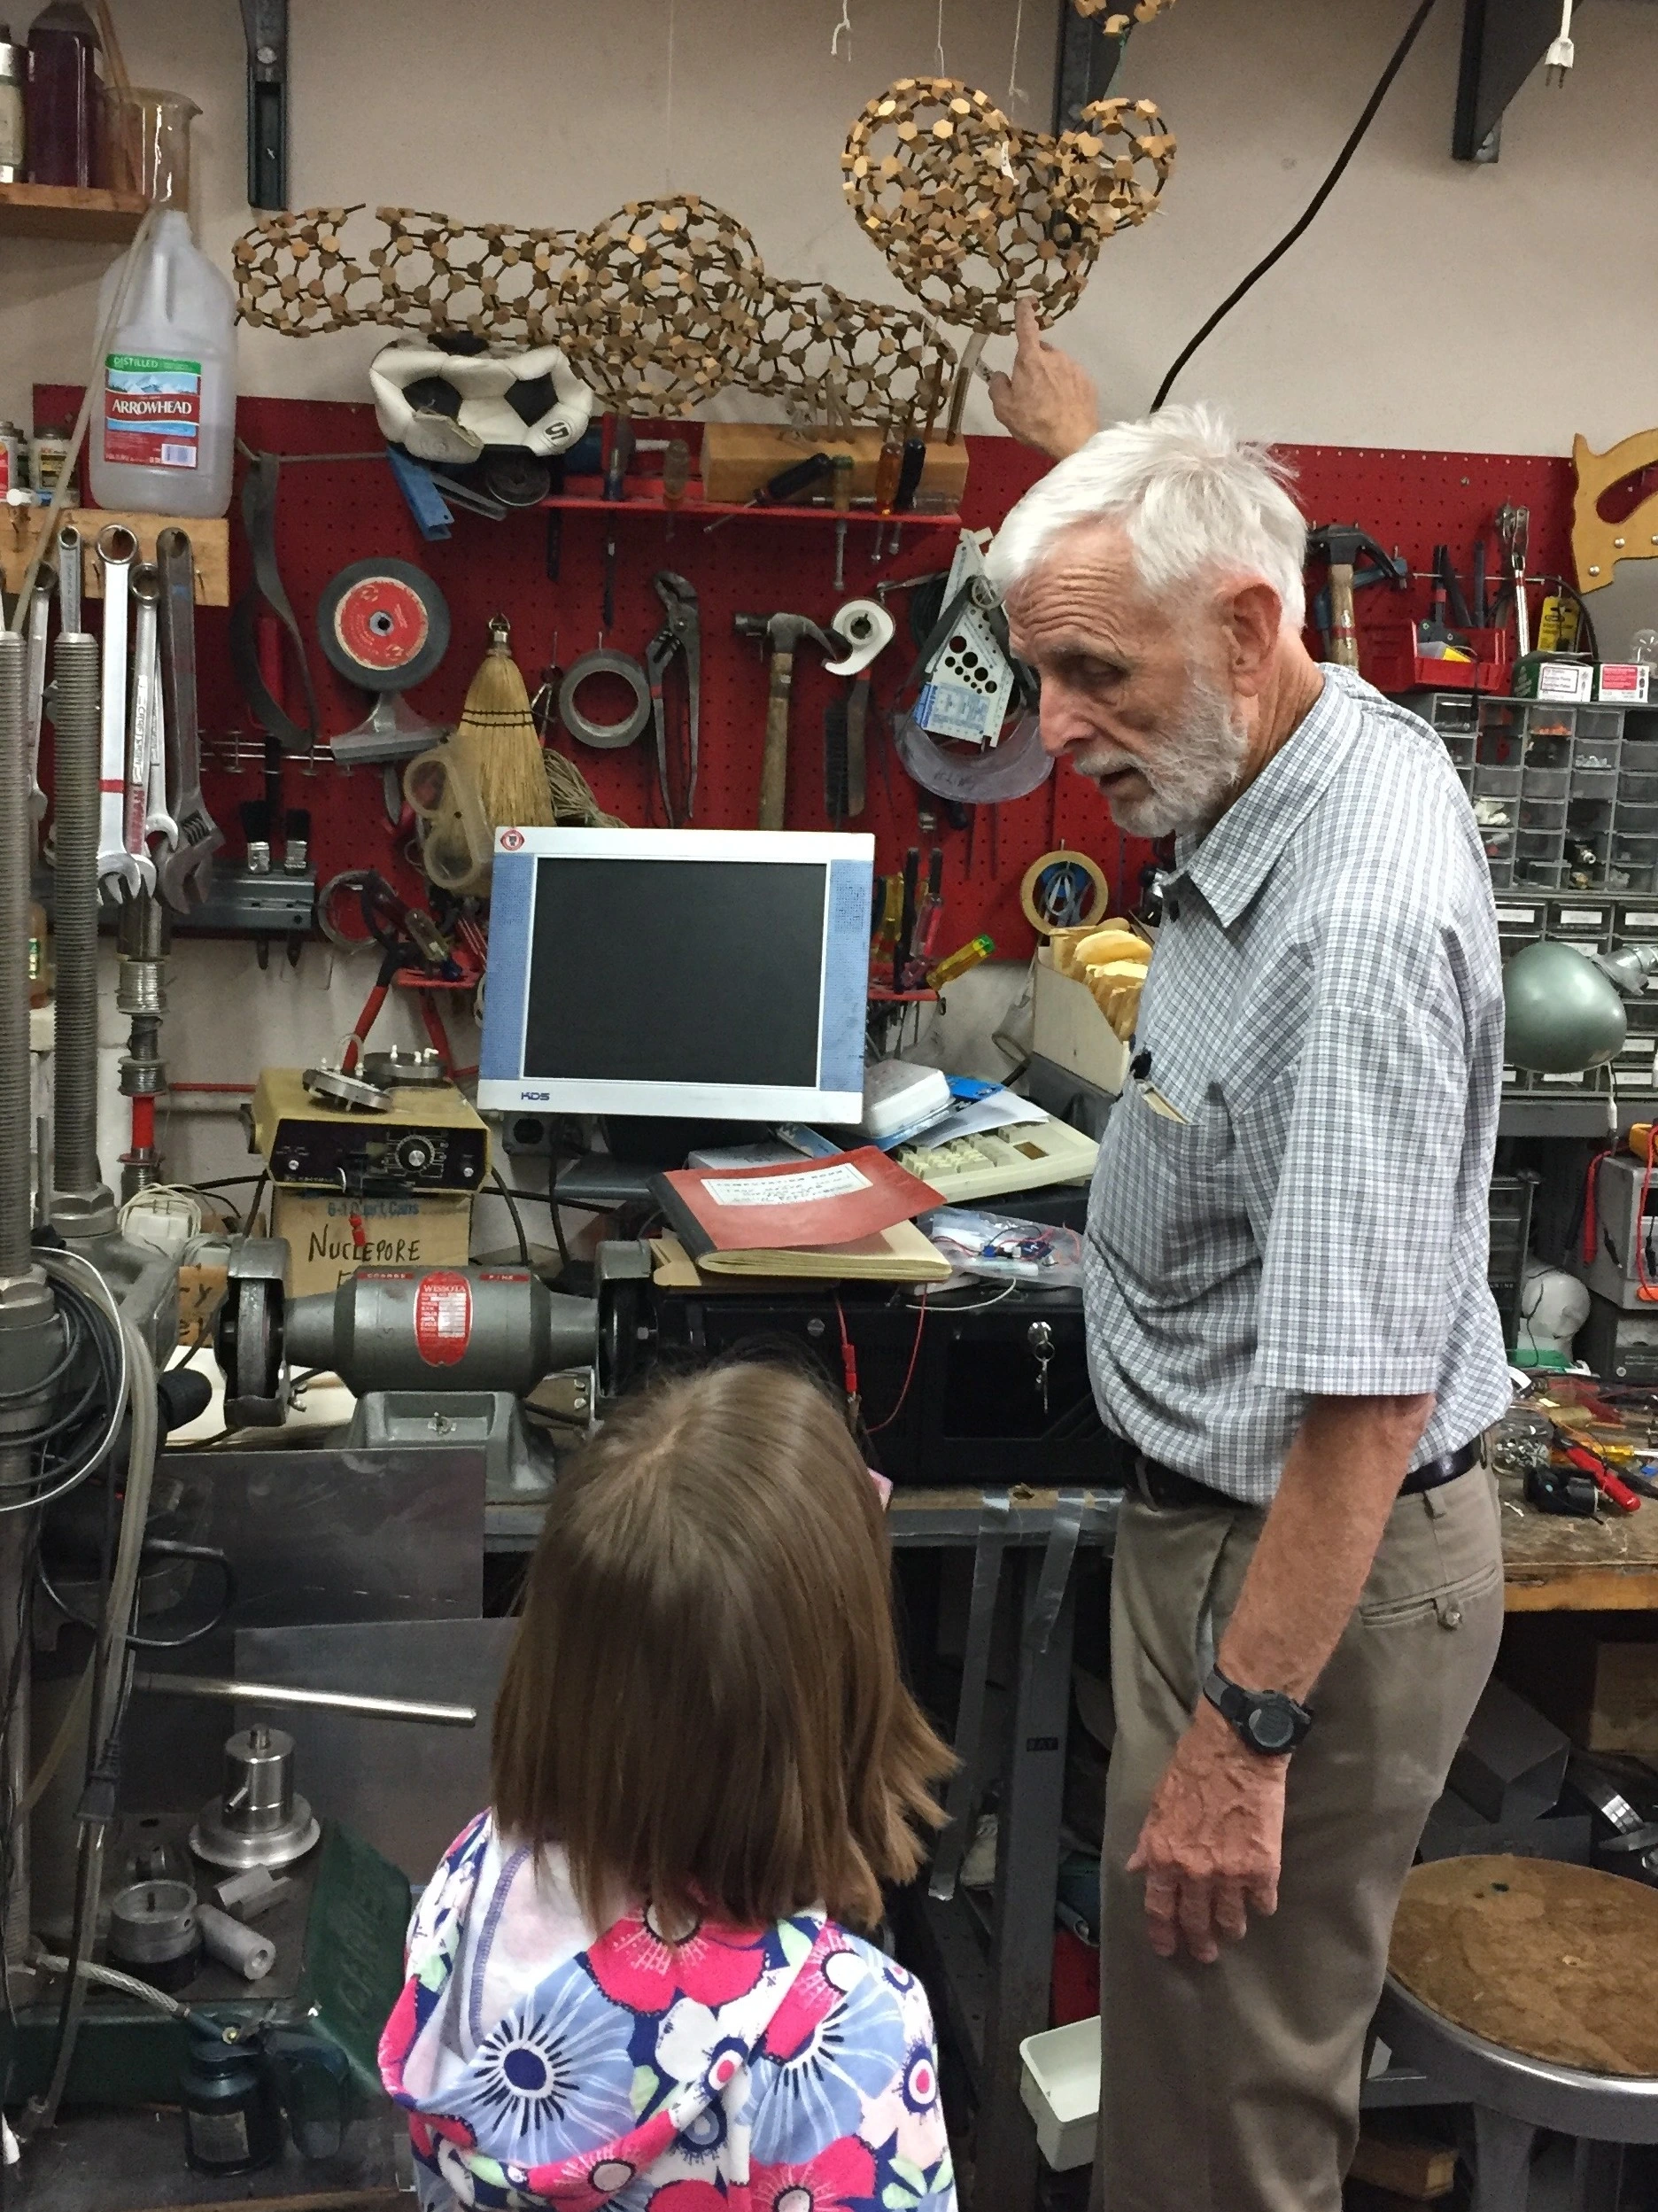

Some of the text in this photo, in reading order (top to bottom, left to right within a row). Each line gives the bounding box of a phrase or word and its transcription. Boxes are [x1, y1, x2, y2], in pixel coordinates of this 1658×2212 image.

[113, 356, 159, 368] DISTILLED
[112, 399, 192, 415] ARROWHEAD
[545, 422, 569, 440] 5
[521, 1091, 550, 1101] KDS
[308, 1223, 421, 1263] NUCLEPORE
